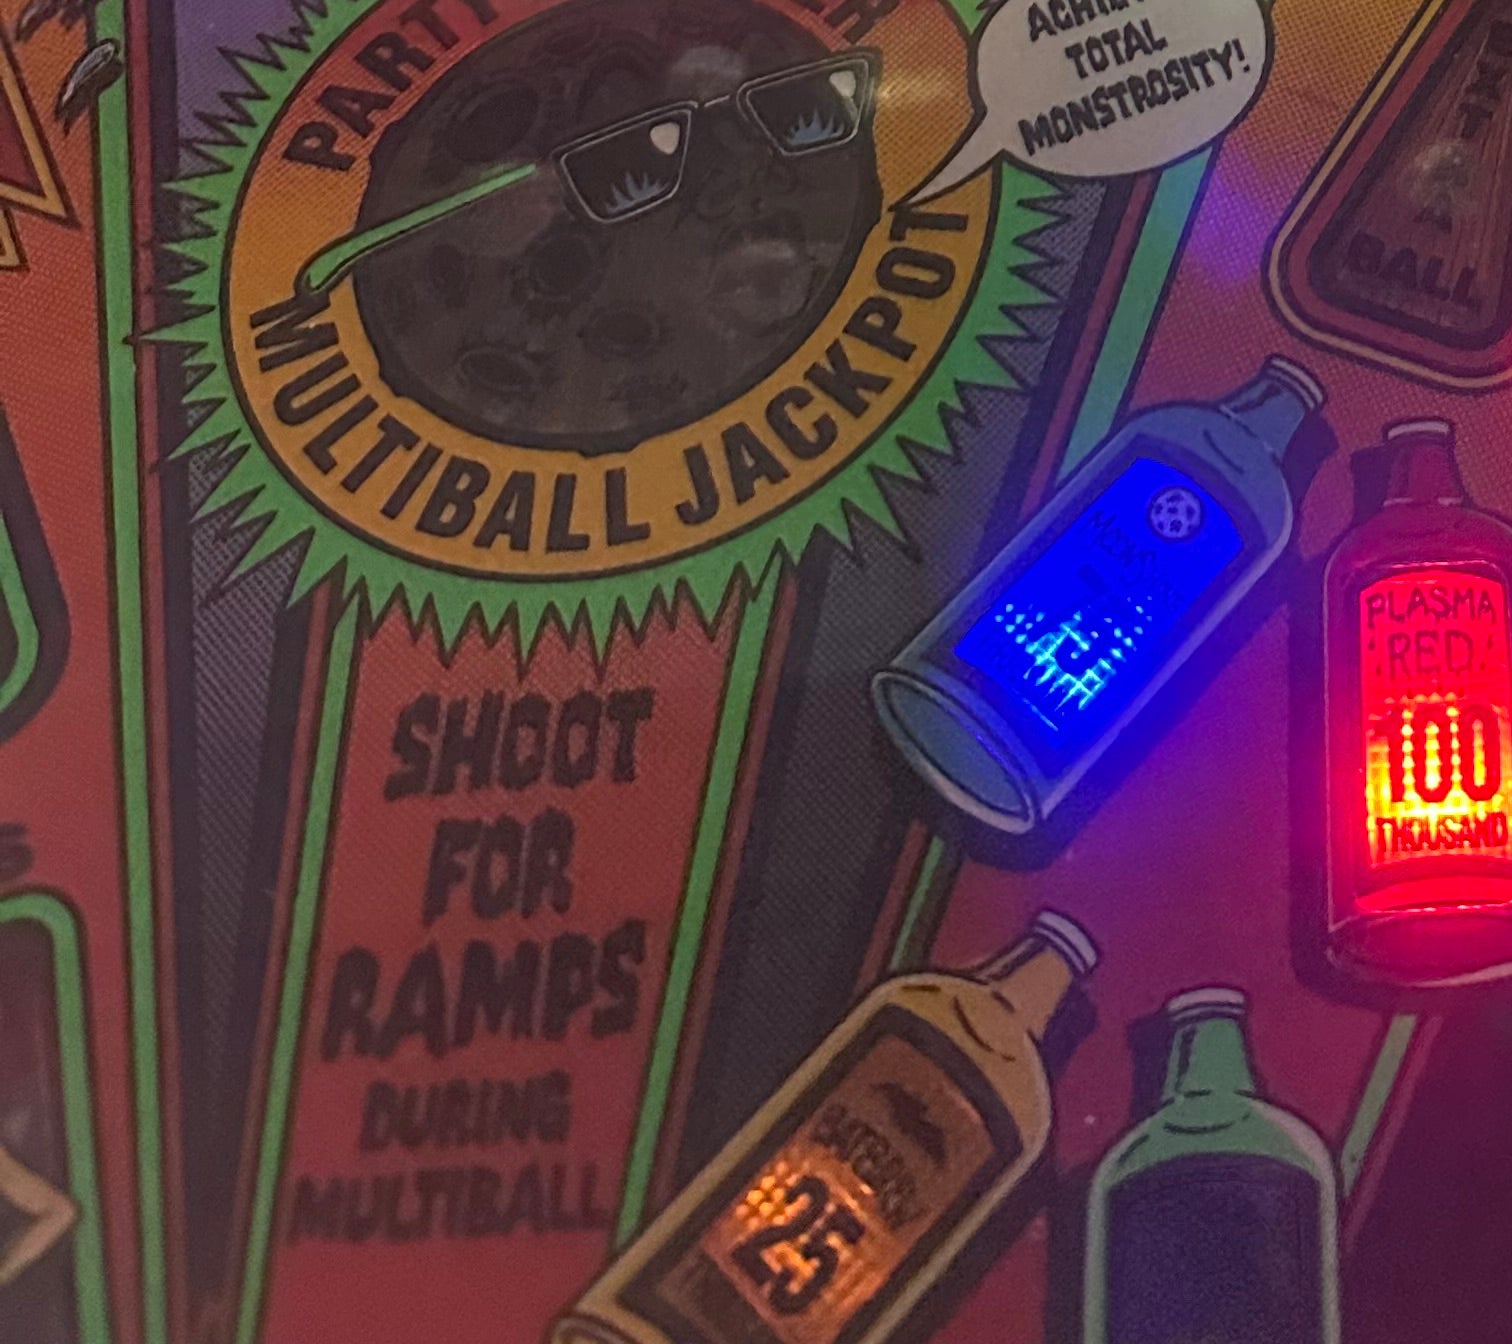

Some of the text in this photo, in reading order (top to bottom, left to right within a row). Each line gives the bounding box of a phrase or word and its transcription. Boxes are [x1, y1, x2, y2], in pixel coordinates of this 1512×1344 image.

[1064, 17, 1169, 80] TOTAL
[1017, 37, 1252, 157] MONSTROSITY!
[1344, 228, 1484, 309] BALL
[248, 205, 972, 558] MULTIBALL JACKPOT
[1364, 585, 1498, 630] PLASMA
[1386, 629, 1475, 677] RED
[383, 688, 656, 804] SHOOT
[1374, 703, 1502, 803] 100
[421, 806, 575, 927] FOR
[1373, 810, 1508, 852] THOUSAND
[318, 919, 648, 1062] RAMPS
[357, 1069, 574, 1153] DURING
[285, 1162, 607, 1247] MULTIBALL
[730, 1174, 865, 1315] 25
